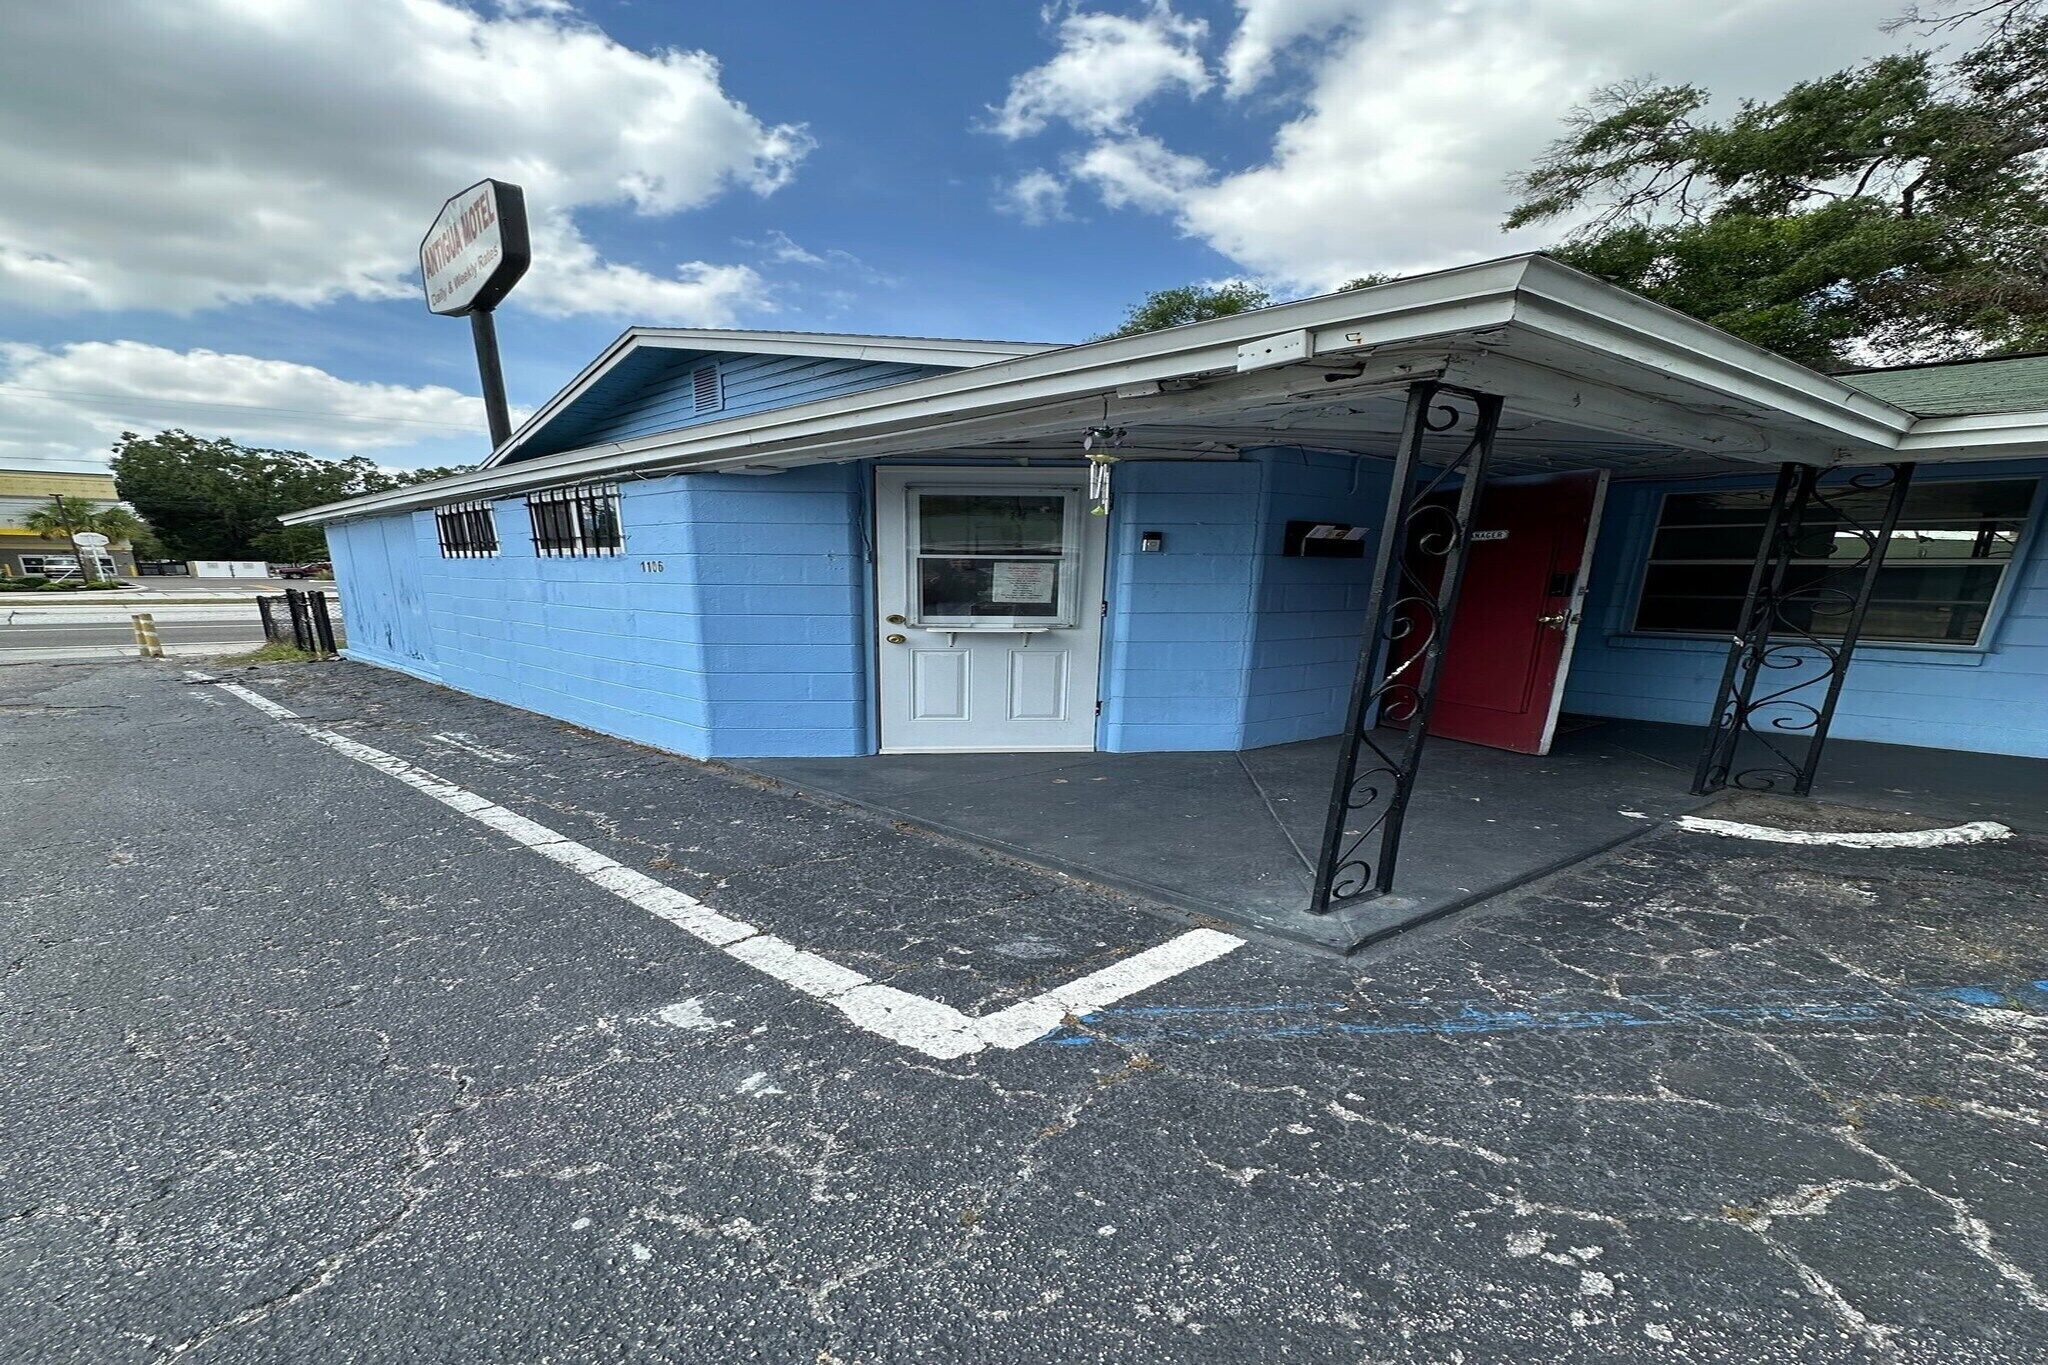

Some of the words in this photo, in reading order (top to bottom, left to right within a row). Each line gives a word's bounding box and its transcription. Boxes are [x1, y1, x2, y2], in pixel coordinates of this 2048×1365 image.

[424, 223, 463, 279] ANTIGUA
[461, 190, 496, 246] MOTEL
[430, 288, 447, 306] Daily
[448, 281, 454, 294] &
[454, 262, 477, 289] Weekly
[477, 245, 499, 270] Rates
